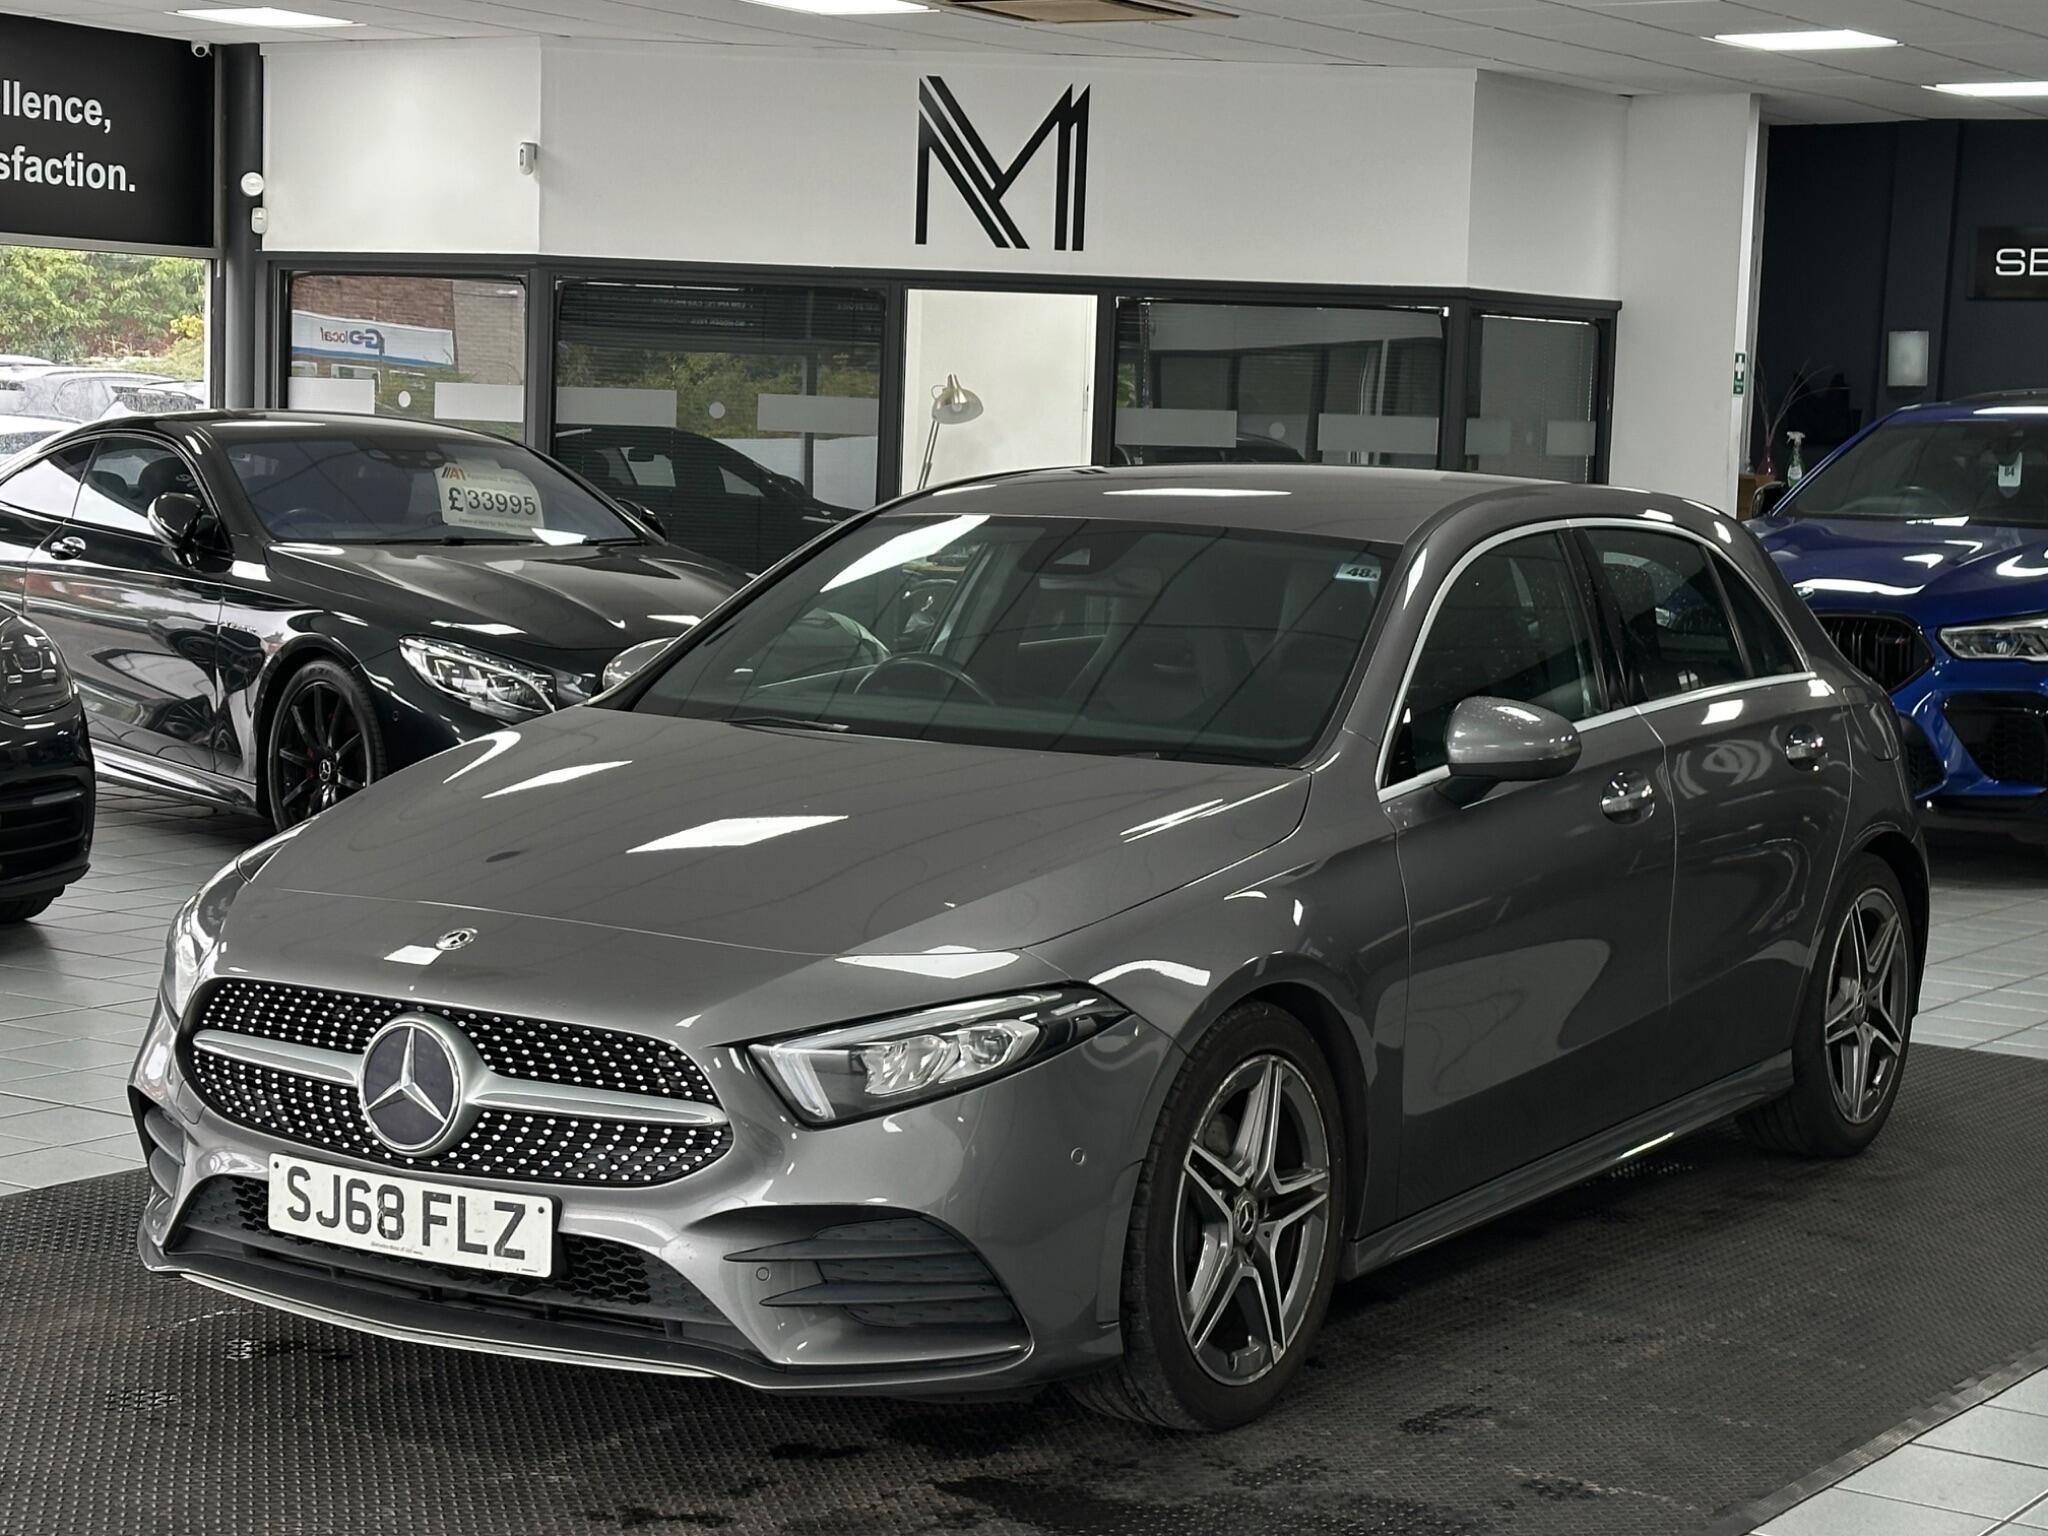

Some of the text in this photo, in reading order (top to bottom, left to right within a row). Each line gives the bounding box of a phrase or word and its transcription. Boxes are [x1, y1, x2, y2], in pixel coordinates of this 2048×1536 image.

[2, 79, 111, 134] llence,
[448, 487, 536, 515] £33995
[286, 1165, 526, 1261] SJ68 FLZ
